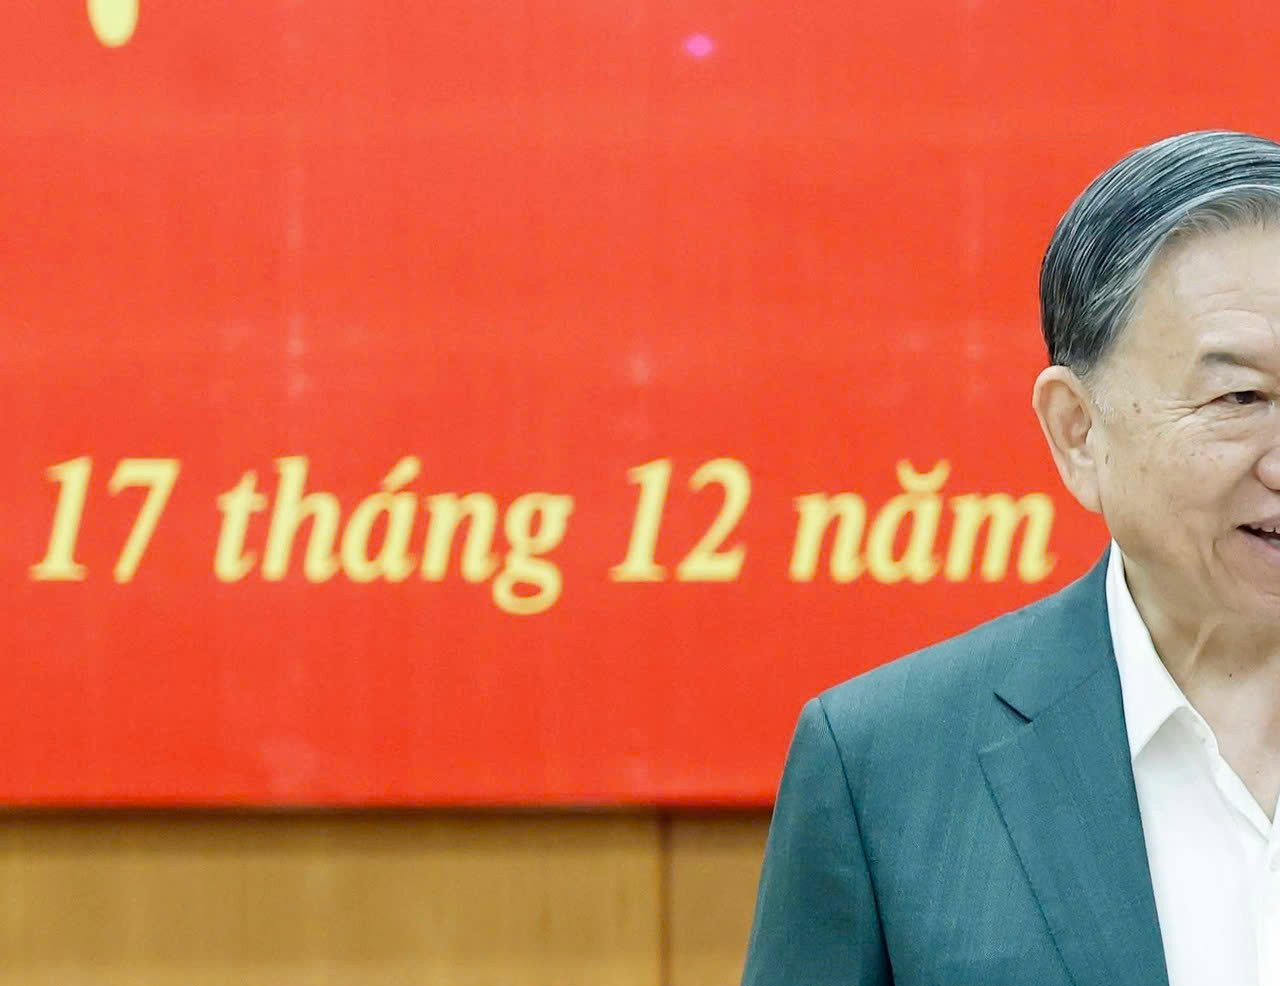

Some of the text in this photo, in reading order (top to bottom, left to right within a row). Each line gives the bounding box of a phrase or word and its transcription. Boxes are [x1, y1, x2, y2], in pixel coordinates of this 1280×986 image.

[30, 455, 1056, 616] 17 tháng 12 năm
